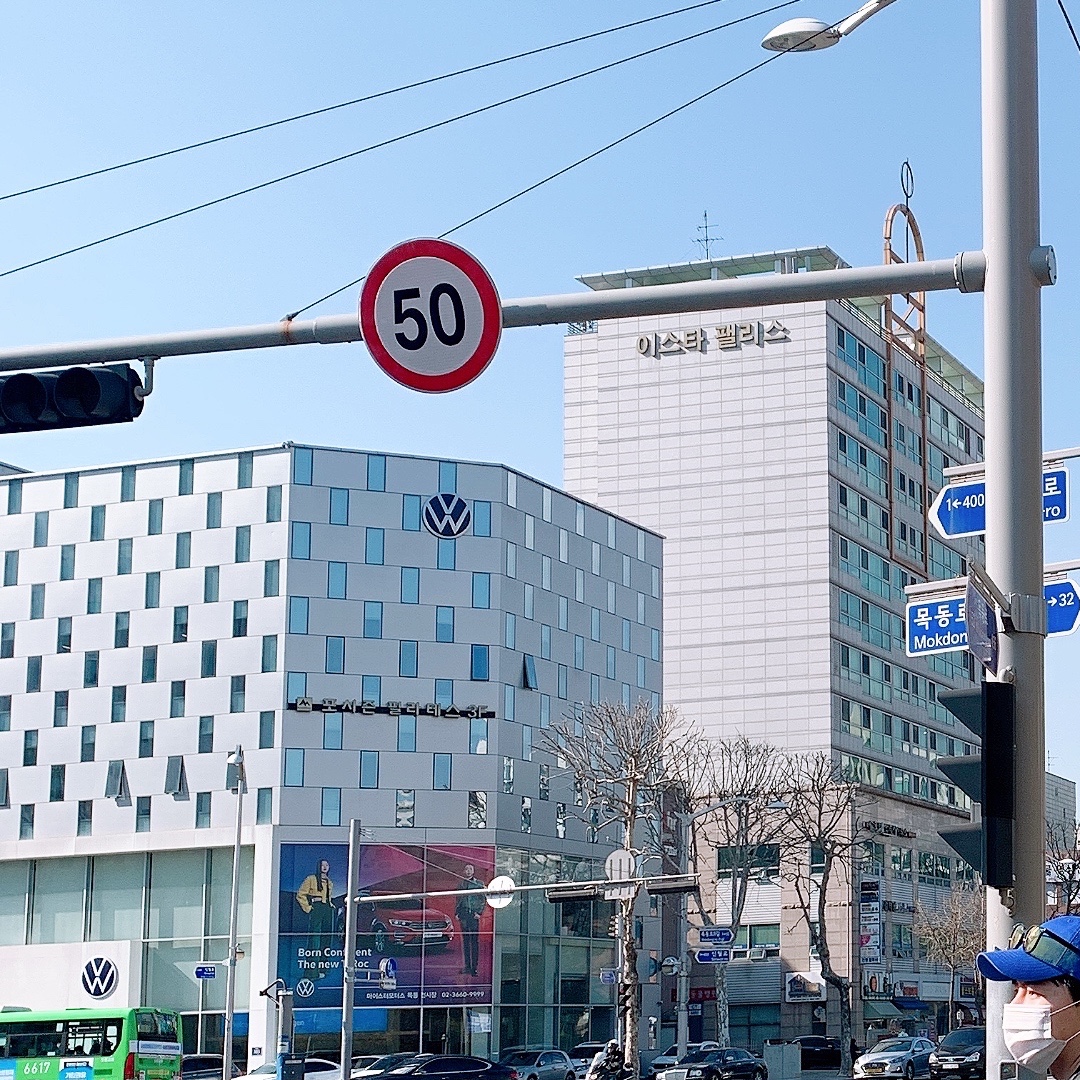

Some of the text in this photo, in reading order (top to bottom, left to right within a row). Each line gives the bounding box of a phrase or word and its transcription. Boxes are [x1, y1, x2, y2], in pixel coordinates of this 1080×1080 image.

[394, 282, 466, 351] 50
[636, 319, 791, 359] 이스타 팰리스
[913, 632, 969, 650] Mokdon
[298, 948, 372, 957] Born Conent
[298, 960, 316, 968] The
[23, 1062, 51, 1075] 6617
